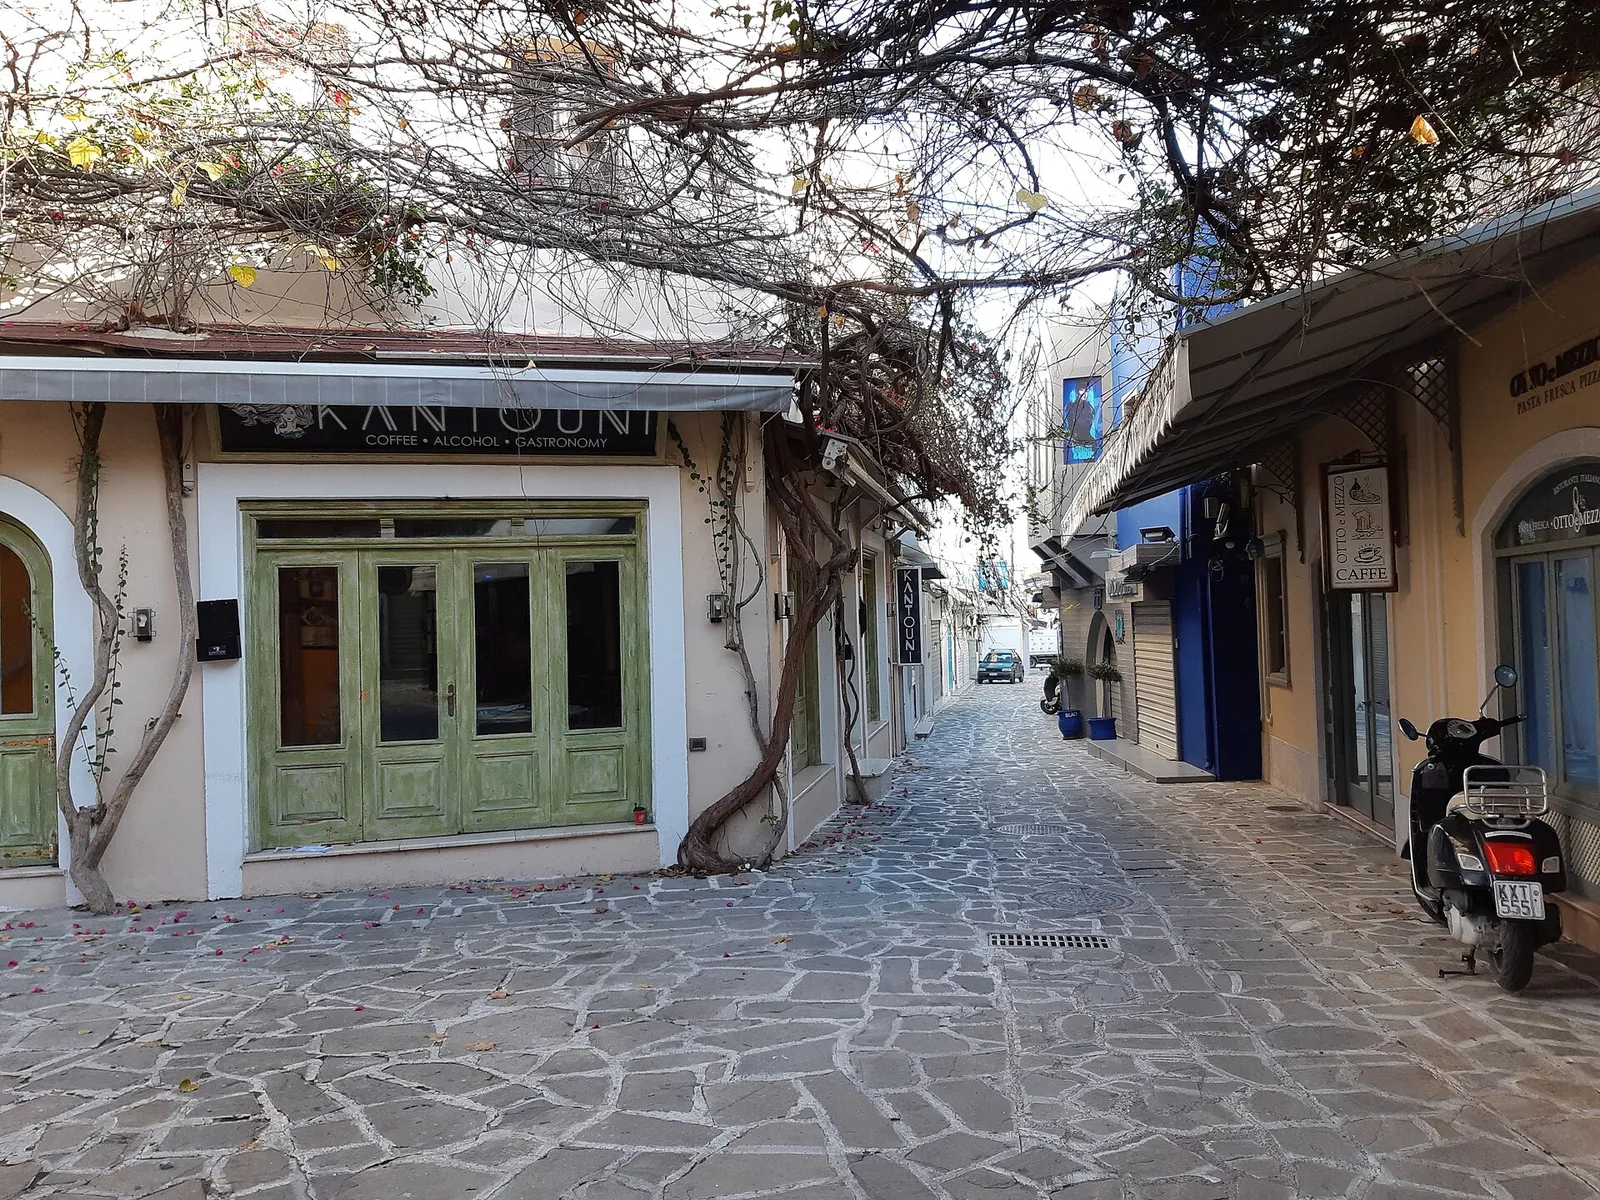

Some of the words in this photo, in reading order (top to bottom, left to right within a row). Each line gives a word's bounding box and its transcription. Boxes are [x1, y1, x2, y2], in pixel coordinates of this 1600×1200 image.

[1517, 396, 1541, 416] PASTA
[1544, 380, 1577, 404] FRESCA
[318, 405, 650, 435] KANTOUNI
[365, 434, 418, 446] COFFEE
[433, 435, 500, 448] ALCOHOL
[515, 436, 608, 448] GASTRONOMY
[1334, 476, 1346, 516] MEZZO
[1553, 514, 1574, 530] OTTO
[1579, 509, 1600, 526] MEZZ
[1336, 528, 1347, 563] OTTO
[1336, 568, 1387, 580] CAFFE
[903, 570, 915, 663] KANTOUNI
[1498, 884, 1528, 900] KXT
[1500, 900, 1531, 915] 555
